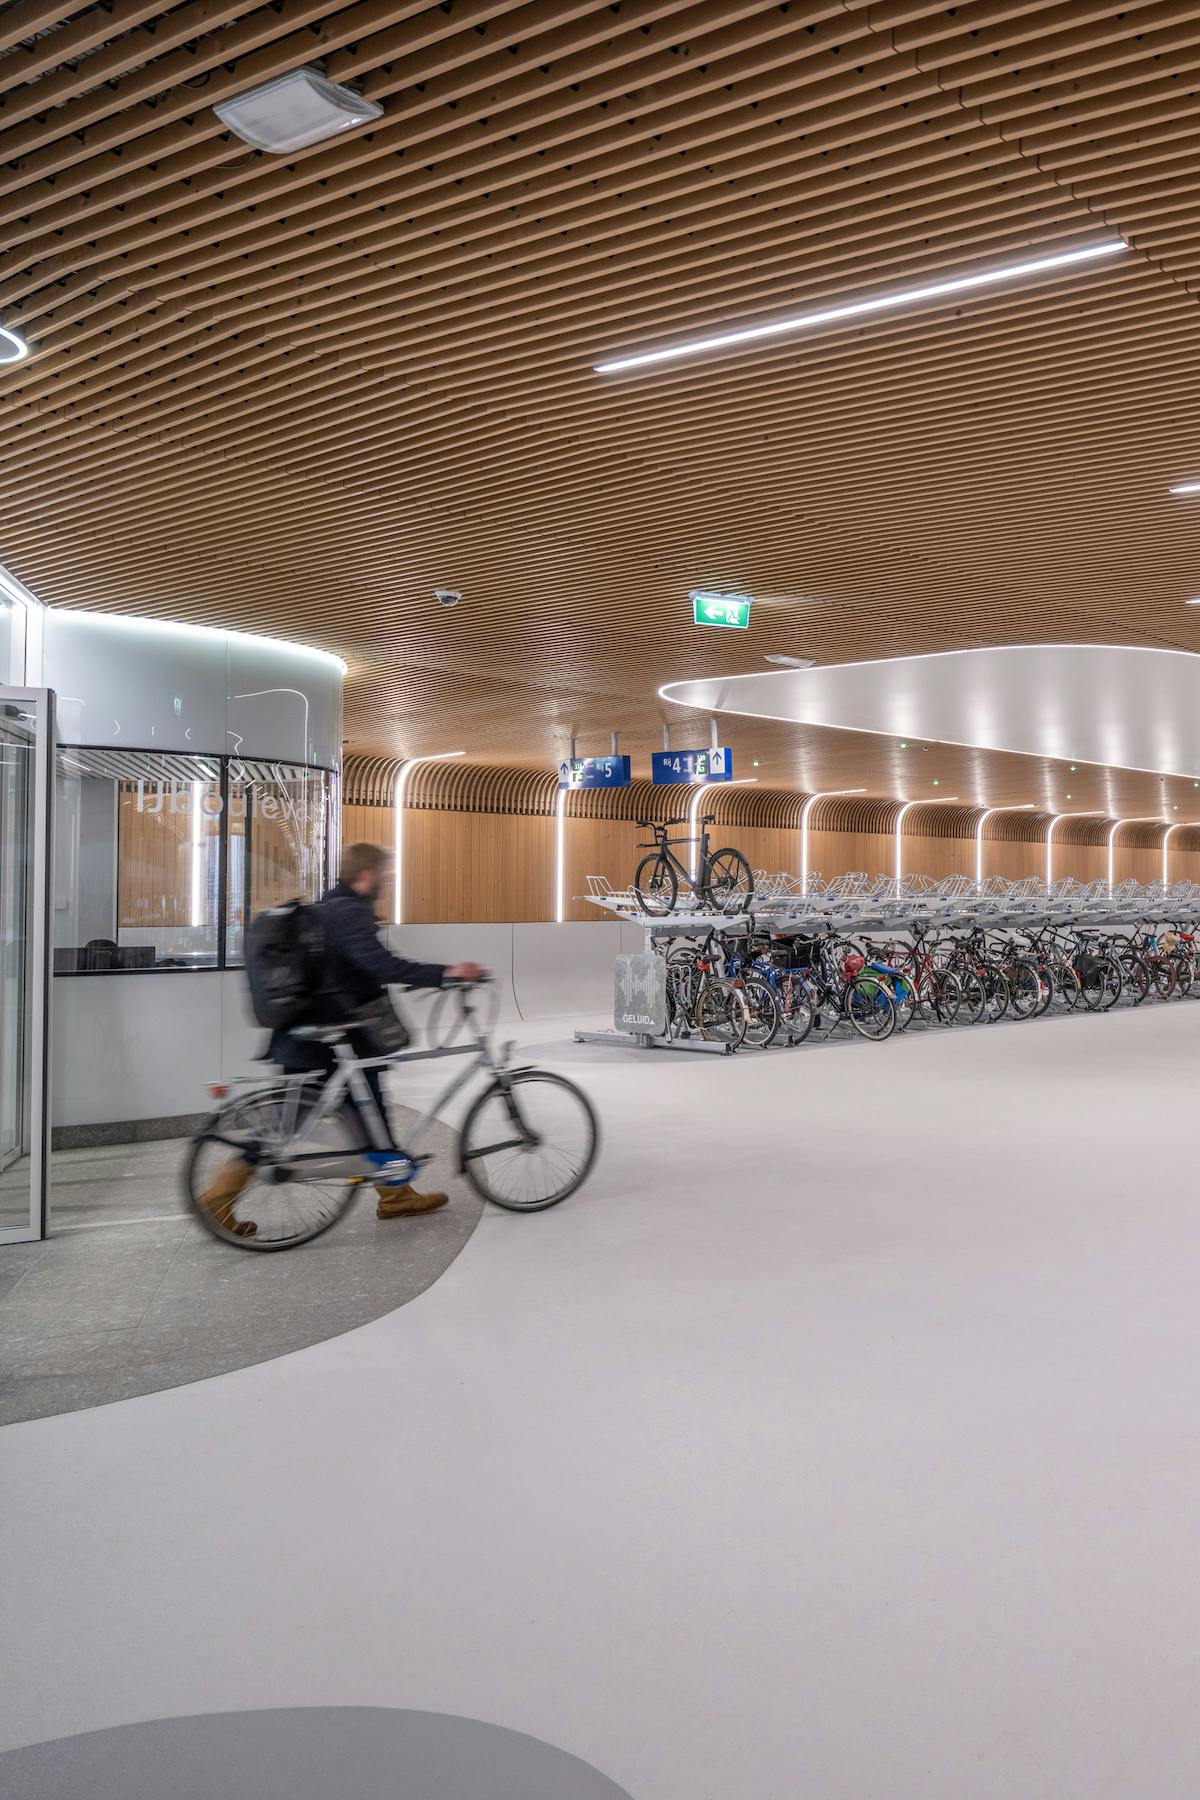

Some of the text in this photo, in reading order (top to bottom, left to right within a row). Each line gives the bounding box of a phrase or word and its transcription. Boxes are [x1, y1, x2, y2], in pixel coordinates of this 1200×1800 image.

[604, 762, 613, 778] 5
[672, 757, 682, 773] 4
[623, 1014, 649, 1024] GELUID
